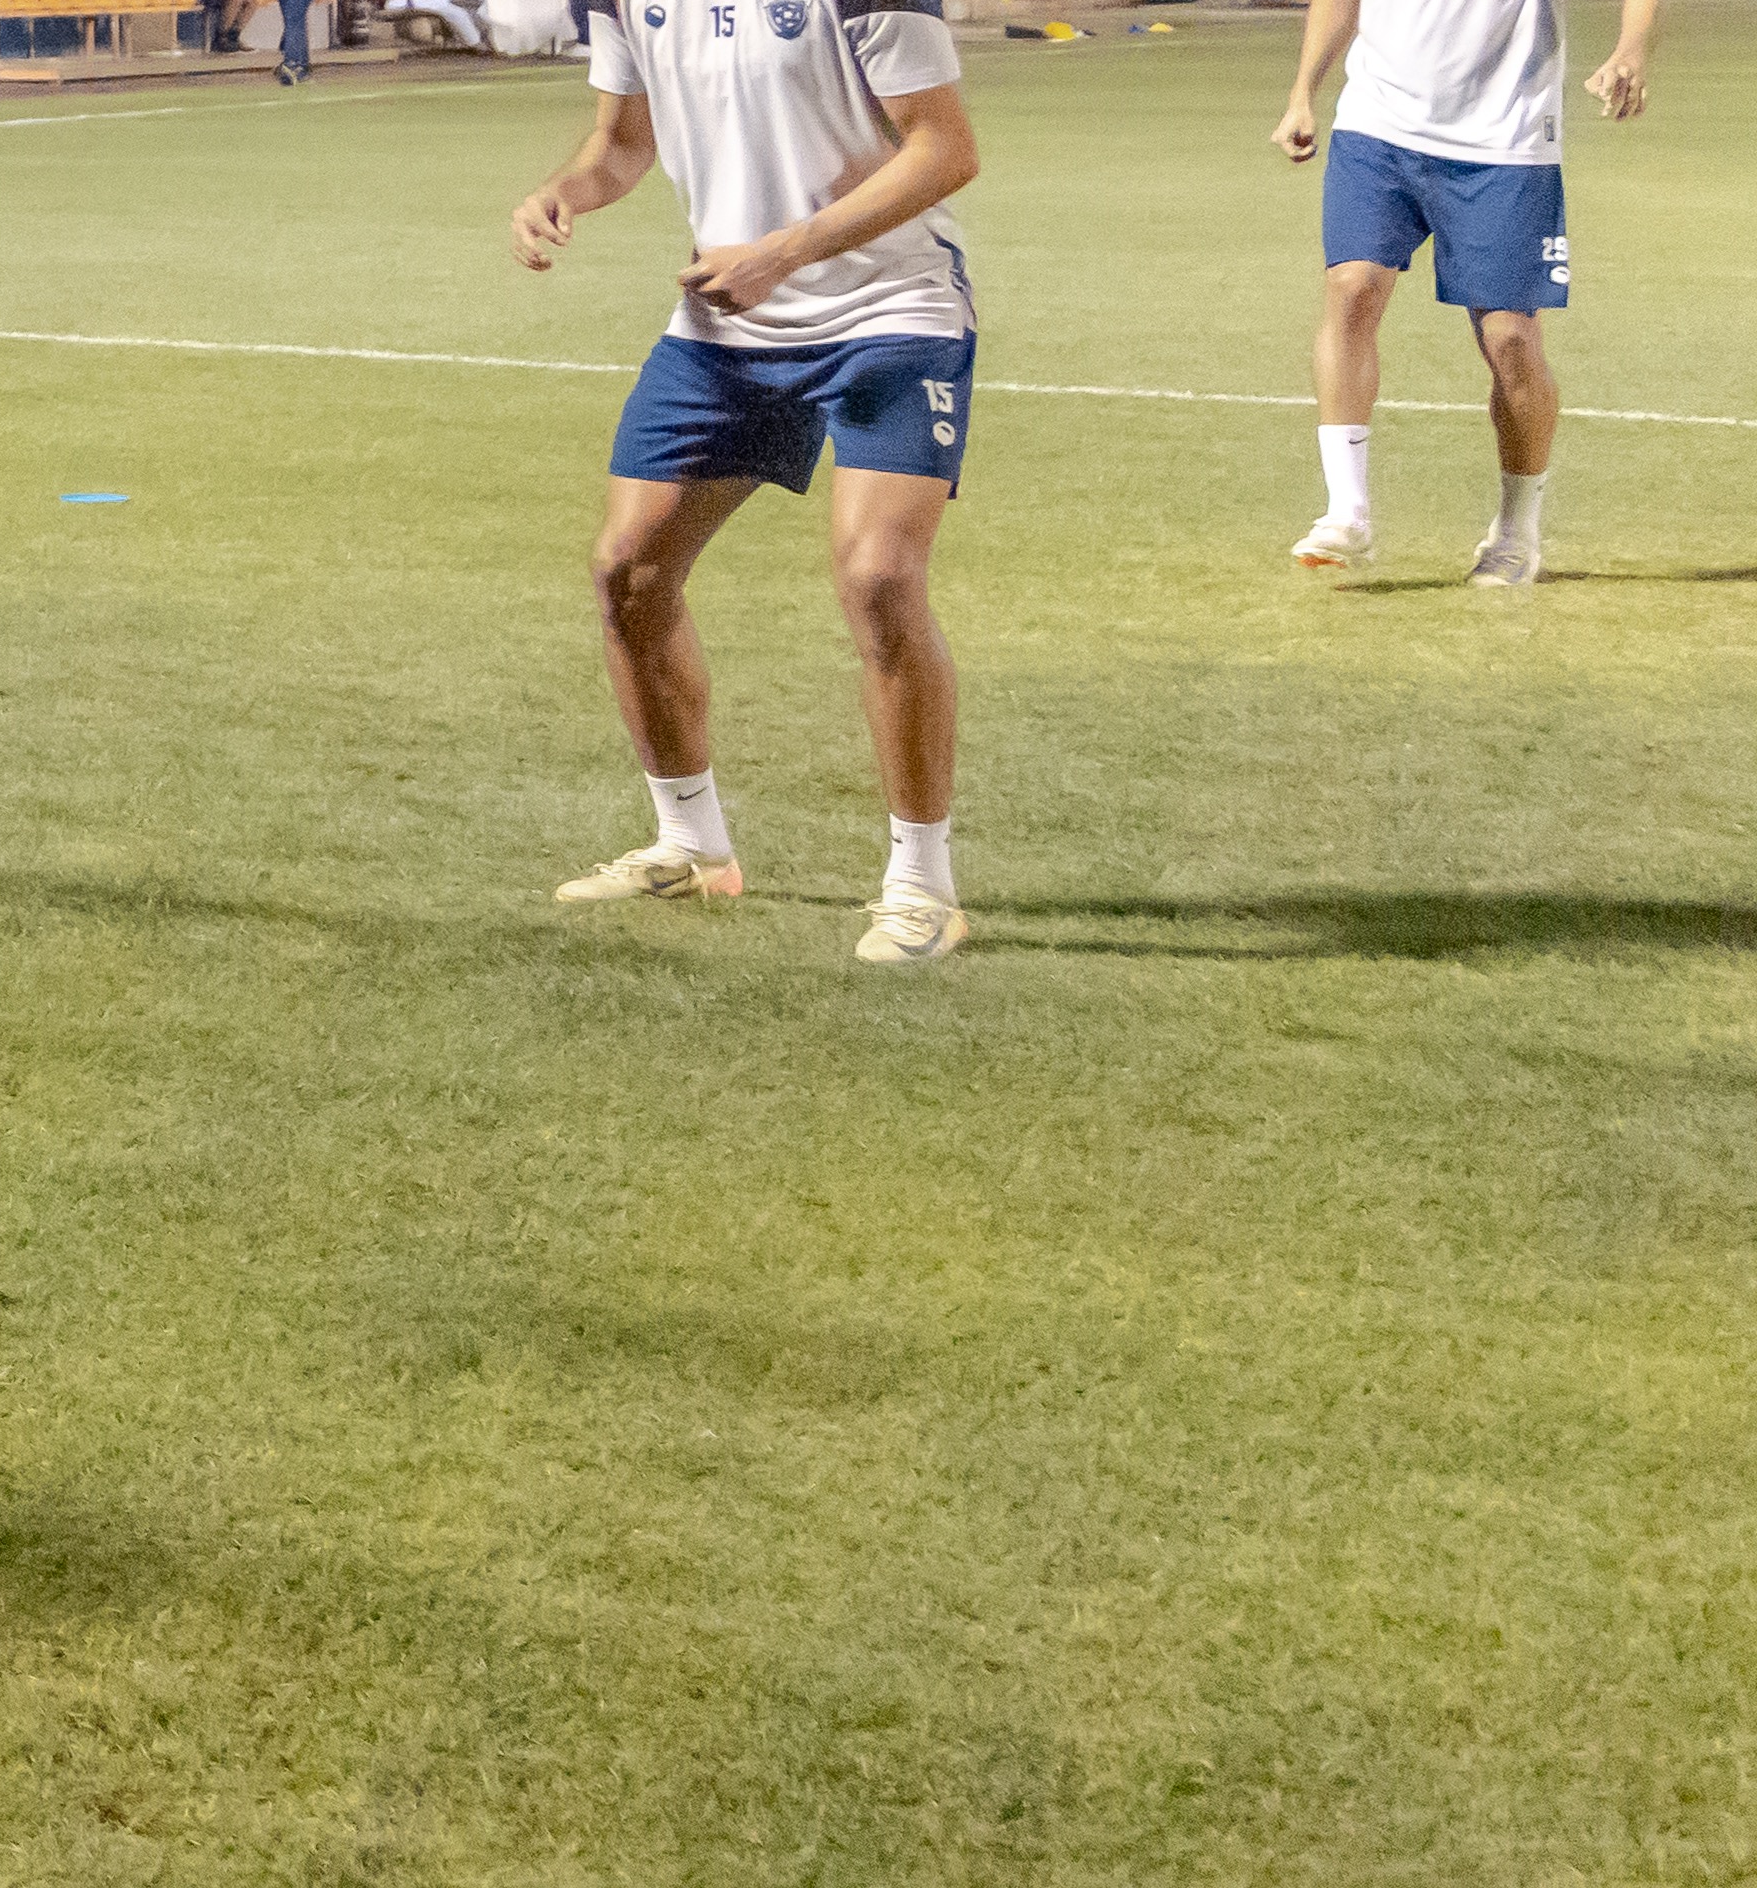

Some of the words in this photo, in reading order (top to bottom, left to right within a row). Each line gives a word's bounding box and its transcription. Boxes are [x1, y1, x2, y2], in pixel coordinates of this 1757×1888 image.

[709, 5, 735, 37] 15
[1542, 236, 1569, 261] 29
[922, 379, 955, 413] 15
